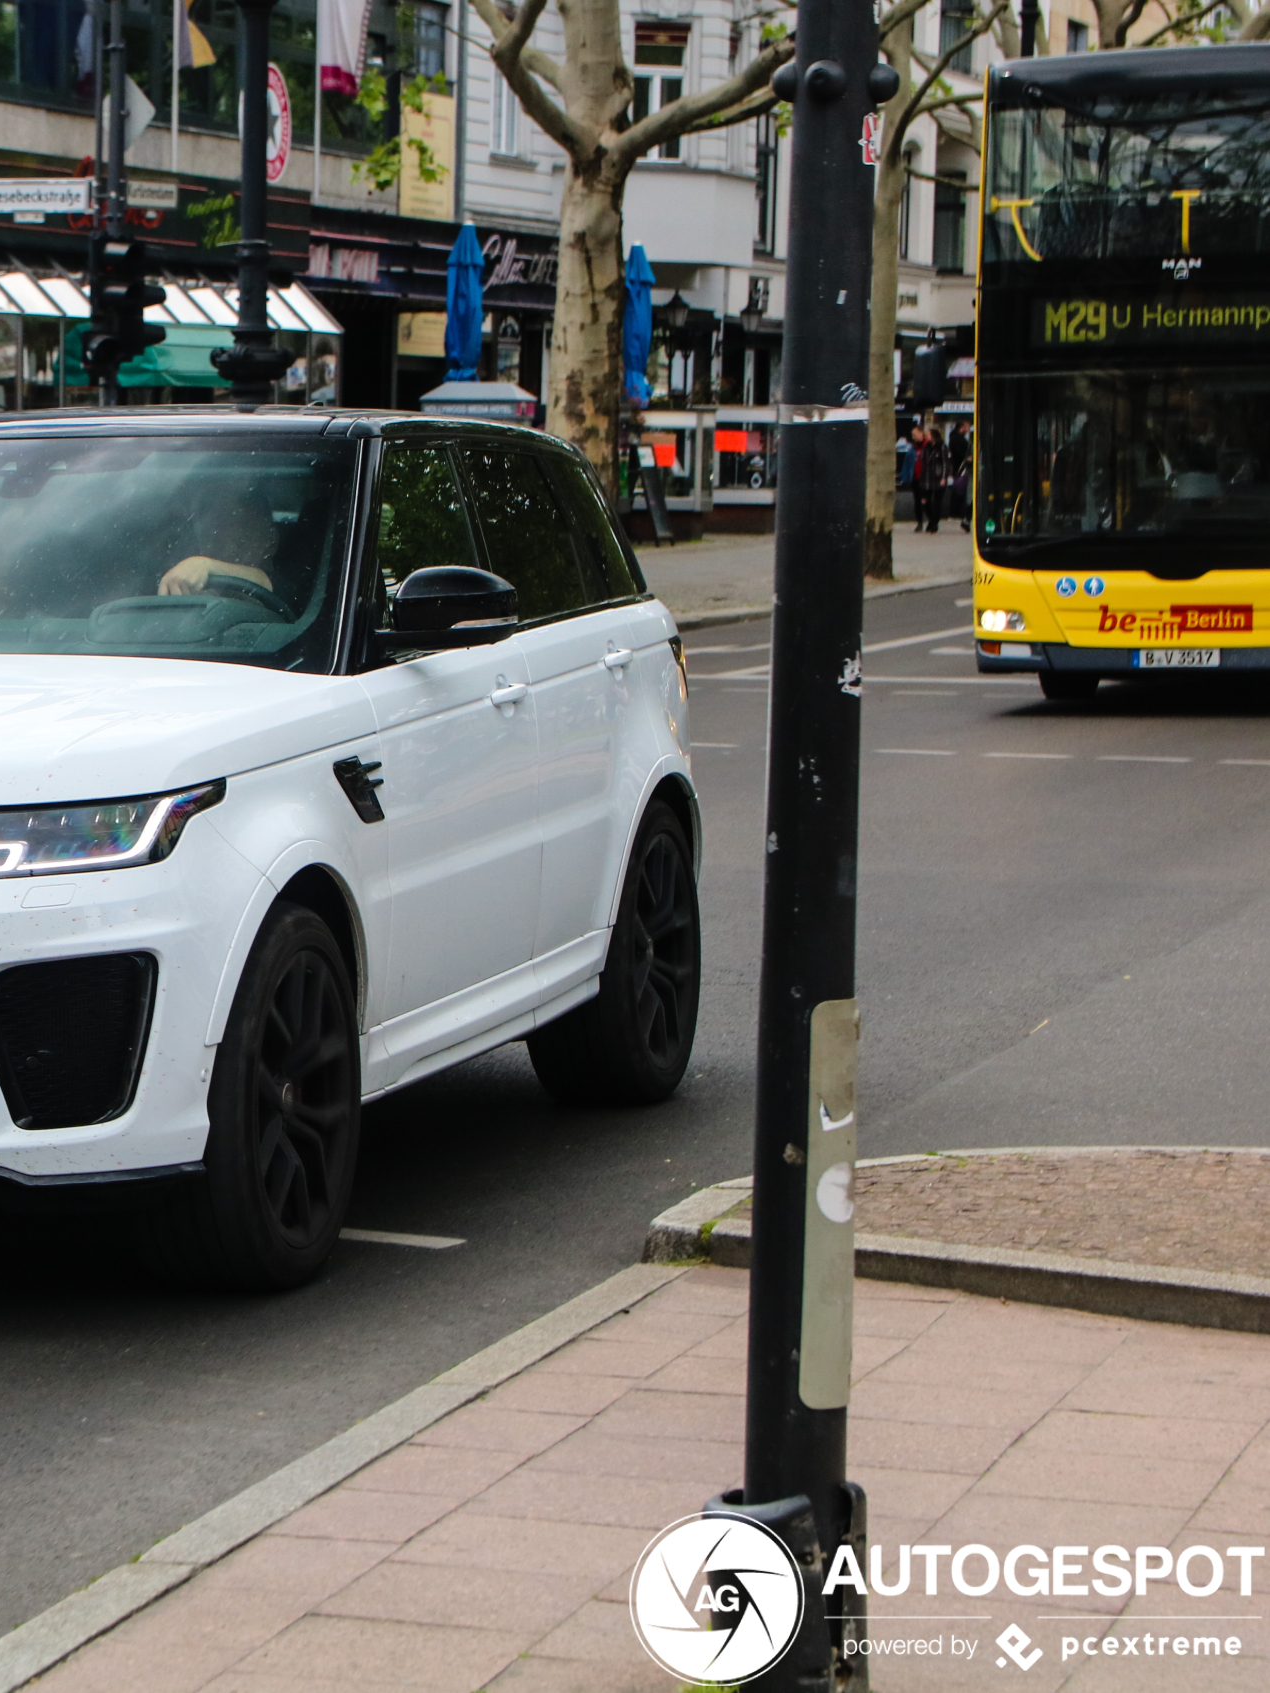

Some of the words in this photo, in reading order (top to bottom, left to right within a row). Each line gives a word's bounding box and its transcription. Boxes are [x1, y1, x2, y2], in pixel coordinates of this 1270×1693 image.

[1161, 257, 1202, 270] MAN
[1045, 301, 1107, 343] M29
[1112, 304, 1131, 330] U
[1142, 302, 1270, 331] Hermannp
[1098, 604, 1137, 634] be
[1186, 609, 1246, 630] Berlin
[1145, 652, 1154, 666] B
[1164, 652, 1174, 665] V
[1178, 651, 1214, 666] 3517
